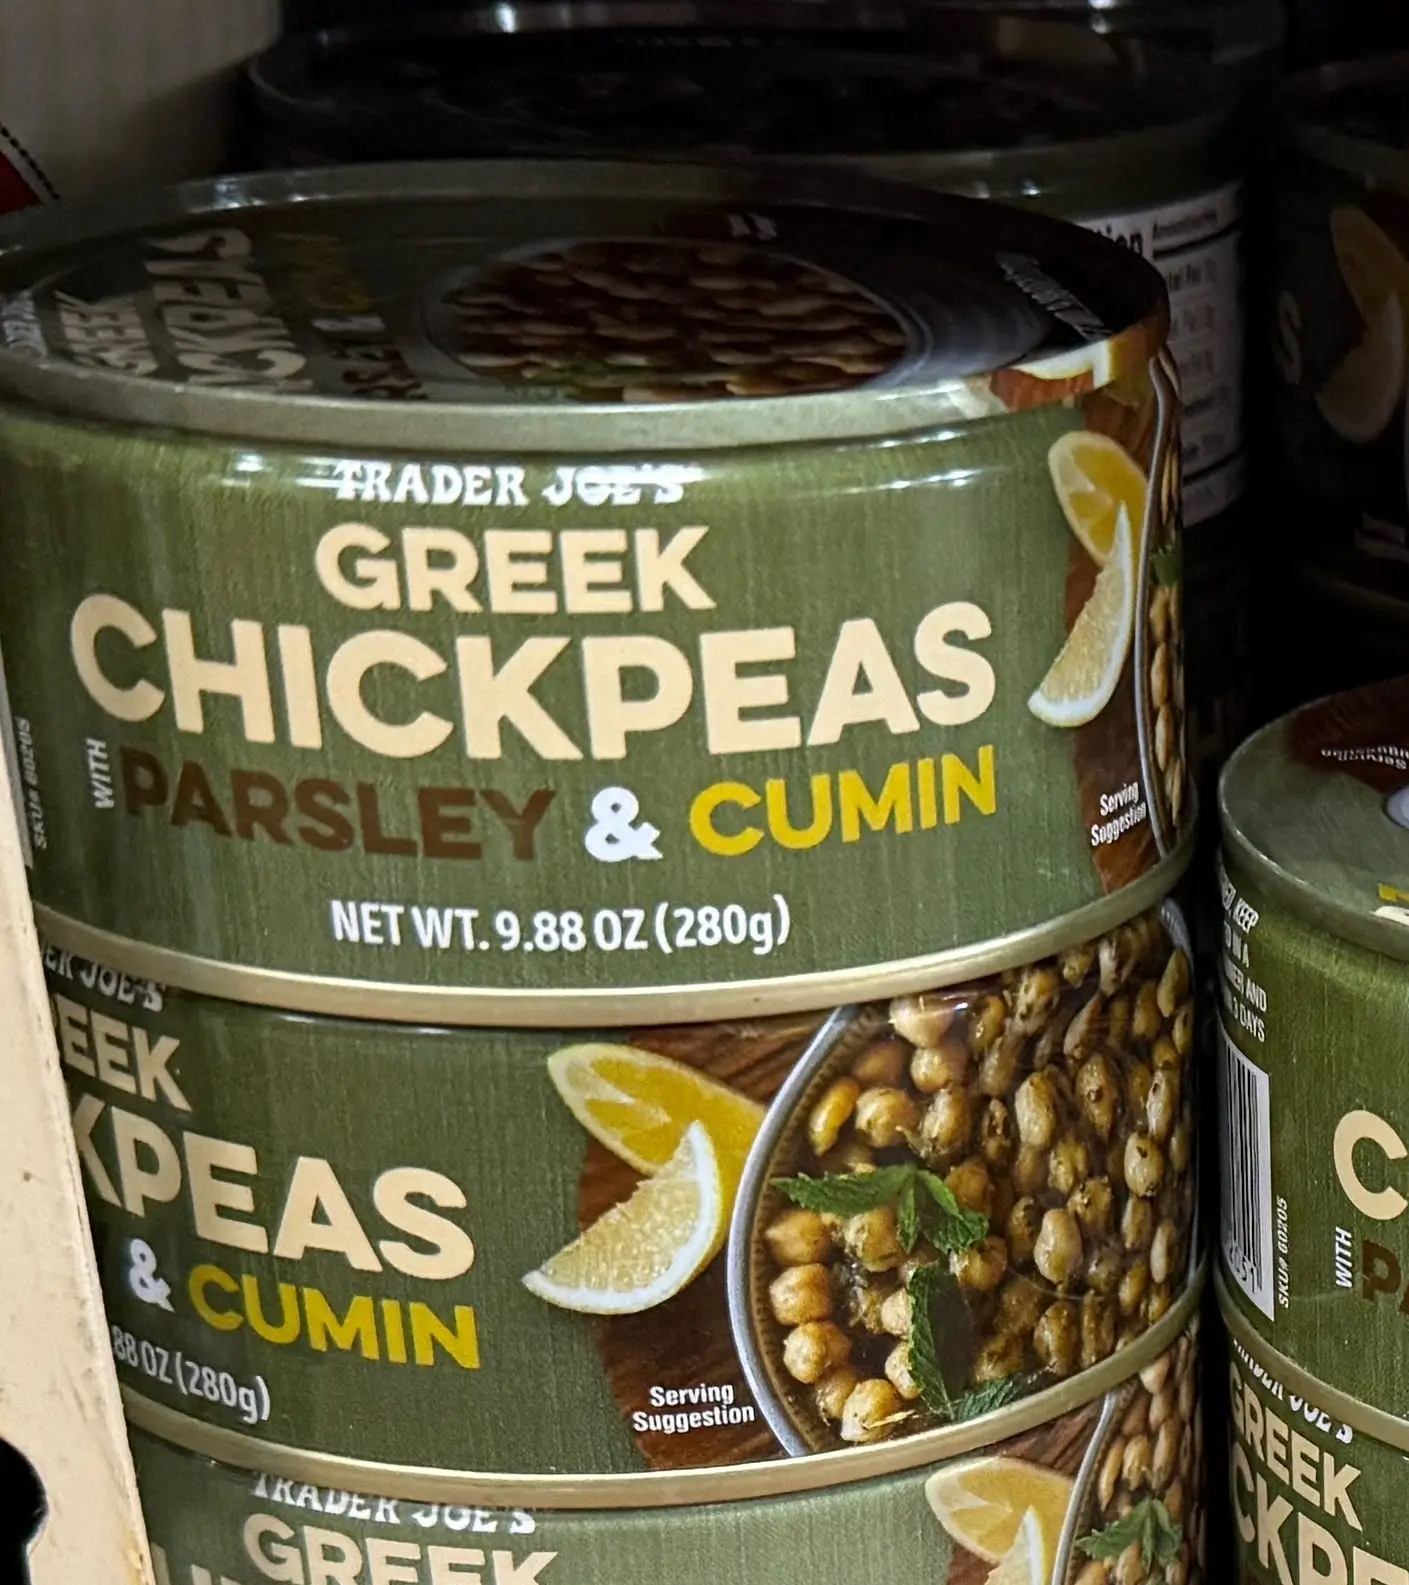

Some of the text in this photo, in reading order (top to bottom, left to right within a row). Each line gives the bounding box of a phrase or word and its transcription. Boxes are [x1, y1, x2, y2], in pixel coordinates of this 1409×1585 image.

[334, 461, 528, 505] TRADER
[315, 522, 717, 613] GREEK
[71, 594, 996, 760] CHICKPEAS
[86, 738, 115, 809] WITH
[119, 747, 558, 861] PARSLEY
[584, 785, 663, 862] &
[689, 745, 996, 856] CUMIN
[1100, 781, 1140, 817] Serving
[330, 894, 791, 955] NET WT. 9.88 OZ (280g)
[1335, 1227, 1354, 1289] WITH
[128, 1236, 481, 1370] & CUMIN
[174, 1355, 271, 1425] (280g)
[632, 1403, 756, 1435] Suggestion
[649, 1383, 735, 1411] Serving
[1228, 1361, 1364, 1533] GREEK
